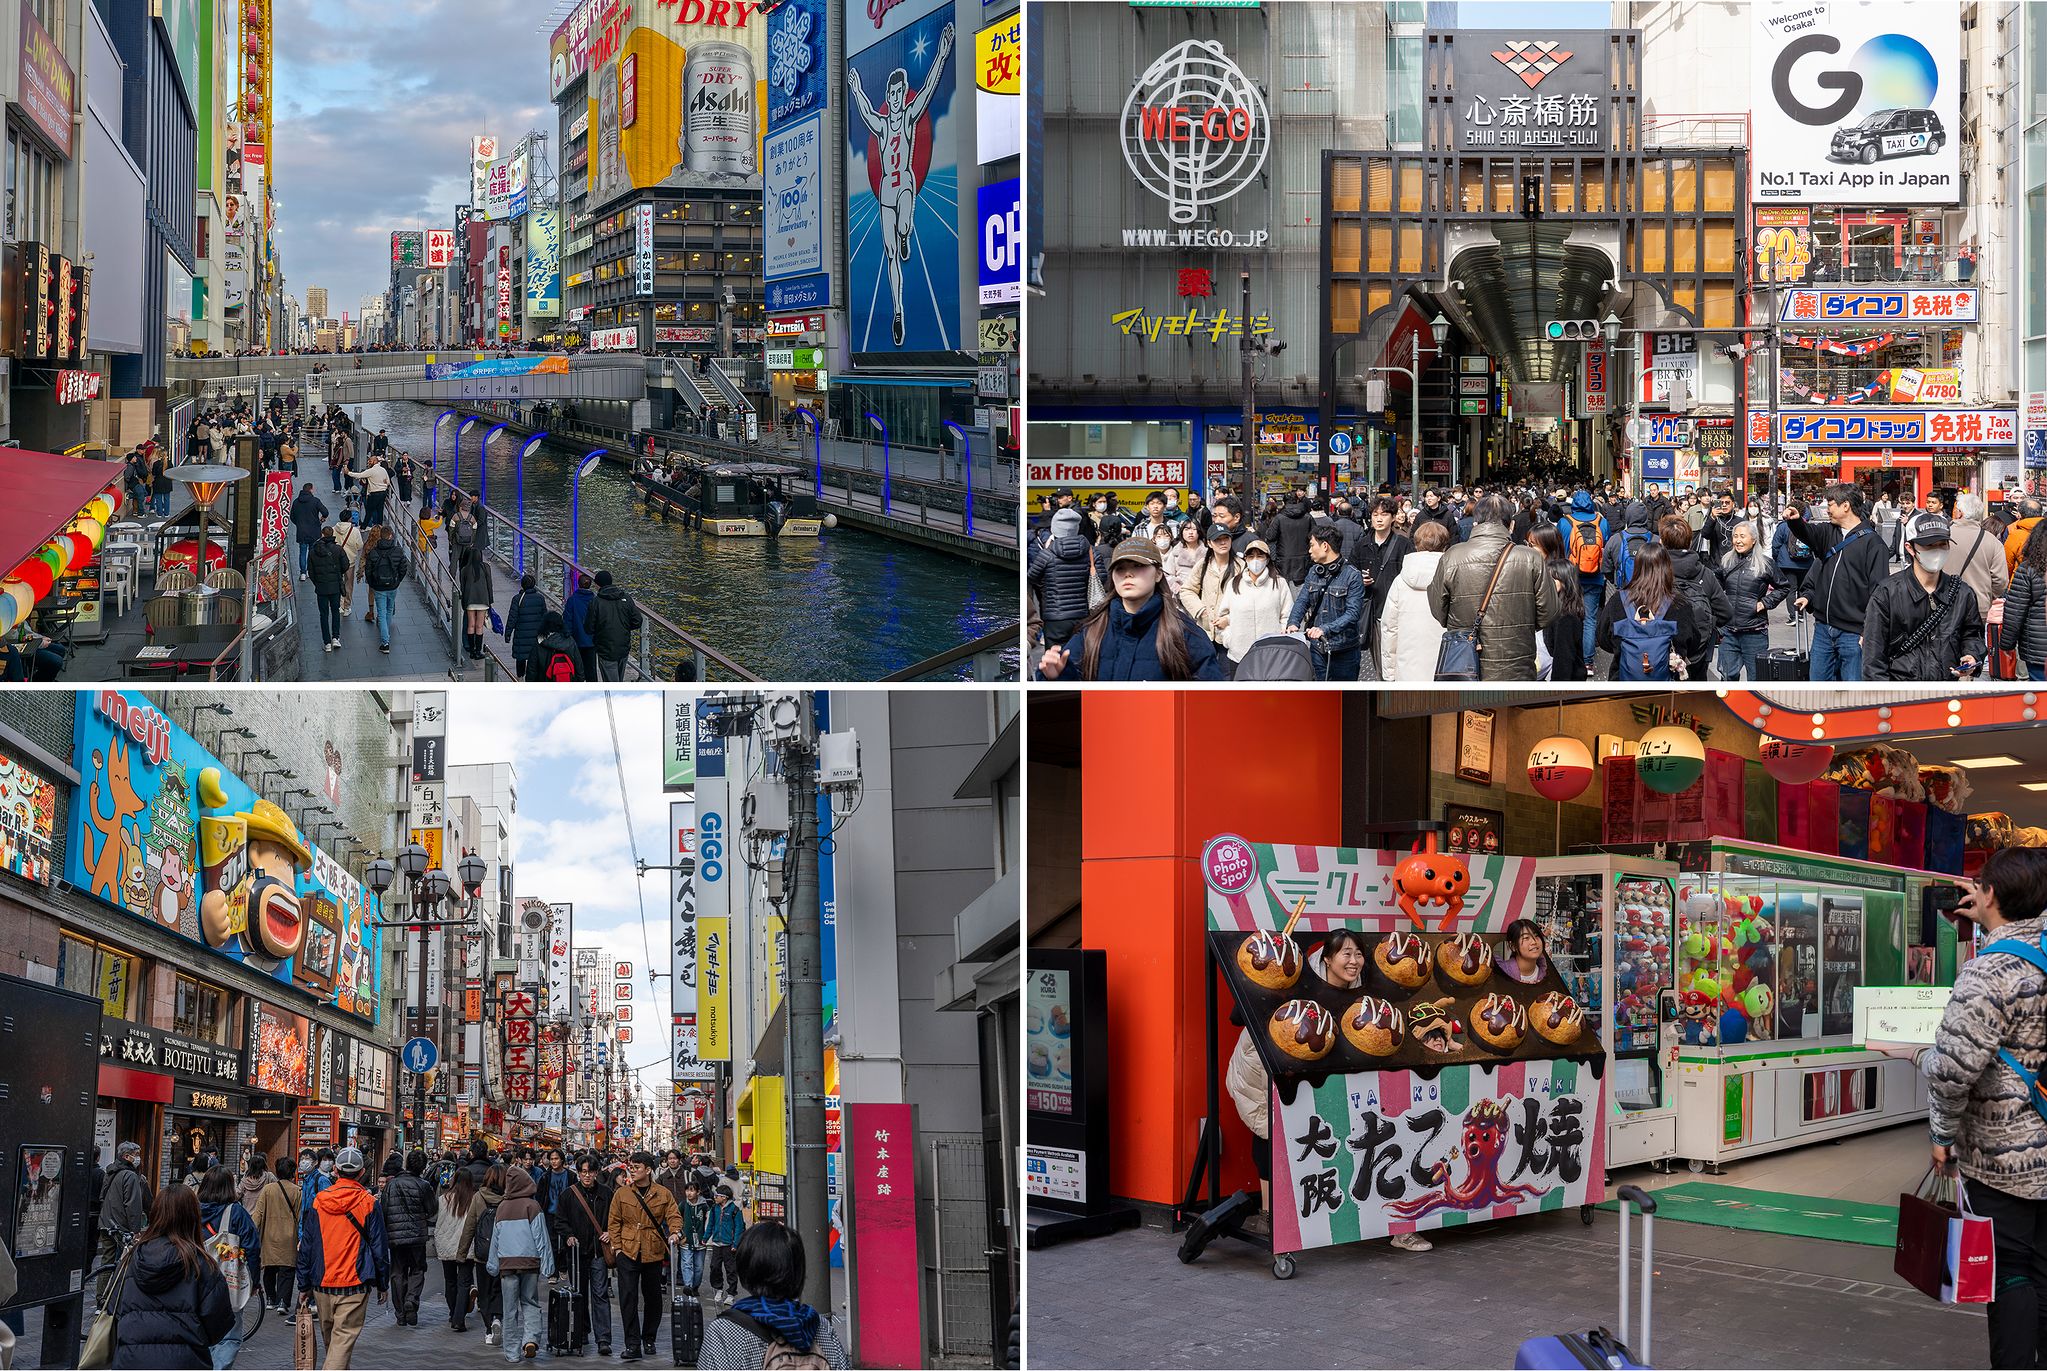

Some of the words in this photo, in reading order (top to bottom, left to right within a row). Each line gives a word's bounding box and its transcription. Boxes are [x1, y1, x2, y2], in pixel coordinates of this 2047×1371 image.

[1768, 9, 1814, 27] Welcome
[1814, 5, 1826, 16] to
[1783, 18, 1817, 34] Osaka!
[25, 20, 49, 75] LONG
[51, 55, 71, 104] DINH
[1772, 33, 1939, 126] GO
[690, 86, 749, 114] Asahi
[771, 91, 813, 123] 雪印メグミルク
[1465, 93, 1599, 127] 心斎橋筋
[713, 115, 728, 127] 生
[1141, 106, 1190, 142] WE
[1202, 107, 1251, 142] GO
[770, 129, 814, 160] 創業100周年
[1466, 130, 1495, 144] SHIN
[1886, 139, 1906, 150] TAXI
[1910, 134, 1926, 148] GO
[775, 157, 808, 176] ありがとう
[890, 132, 901, 188] グリコ
[489, 165, 506, 182] 入店
[1761, 172, 1794, 186] No.1
[1799, 172, 1834, 186] Taxi
[1840, 172, 1874, 189] App
[1880, 171, 1893, 186] in
[1899, 172, 1950, 189] Japan
[776, 217, 809, 237] Anniversary
[536, 212, 559, 273] シャッターは
[1122, 229, 1269, 247] WWW.WEGO.JP
[1757, 228, 1811, 265] 20%
[498, 267, 510, 318] 大阪王将
[1177, 267, 1213, 298] 薬
[39, 247, 49, 356] たこ焼き
[783, 291, 817, 306] 雪印メグミルク
[1794, 291, 1819, 319] 薬
[1826, 296, 1905, 316] ダイコク
[1912, 294, 1953, 316] 免税
[775, 322, 805, 334] ZETTERIA
[1111, 306, 1276, 343] マツモトキヨシ
[985, 323, 1009, 348] くくる
[1590, 354, 1602, 391] ダイコク
[1657, 369, 1693, 380] BRAND
[464, 385, 519, 394] えびす橋
[1657, 380, 1692, 391] STE
[1925, 385, 1957, 398] 4780
[1587, 394, 1606, 407] 免税
[1785, 416, 1920, 440] ダイコクドラッグ
[1930, 413, 1983, 442] 免税
[1988, 416, 2010, 428] Tax
[1701, 434, 1733, 442] BRAND
[1987, 428, 2013, 440] Free
[1027, 463, 1053, 481] Tax
[1055, 463, 1094, 482] Free
[1098, 463, 1143, 484] Shop
[1148, 462, 1185, 484] 免税
[97, 690, 172, 767] meiji
[675, 702, 691, 762] 道頓堀店
[1530, 750, 1559, 767] クレーン
[1639, 740, 1672, 756] クレーン
[1767, 743, 1791, 760] 横丁
[832, 769, 853, 777] M12M
[1534, 765, 1556, 782] 横丁
[1643, 756, 1668, 773] 横丁
[421, 786, 441, 825] 白木屋
[1458, 814, 1490, 824] ハウスルール
[701, 812, 722, 883] GiGO
[1213, 857, 1249, 877] Photo
[1220, 868, 1248, 887] Spot
[316, 853, 360, 905] 大阪名物
[705, 932, 720, 997] マツモトキヨシ
[617, 963, 630, 1041] かに道楽
[504, 991, 535, 1100] 大阪王将
[163, 1047, 212, 1075] BOTEJYU
[1028, 1081, 1051, 1089] REVOLVING
[1528, 1076, 1574, 1093] YAKI
[191, 1091, 229, 1111] 星乃珈琲店
[1037, 1092, 1058, 1111] 150
[1058, 1095, 1071, 1106] YEN
[1346, 1097, 1584, 1202] たこ焼
[874, 1129, 892, 1196] 竹本座跡
[1295, 1114, 1344, 1219] 大阪
